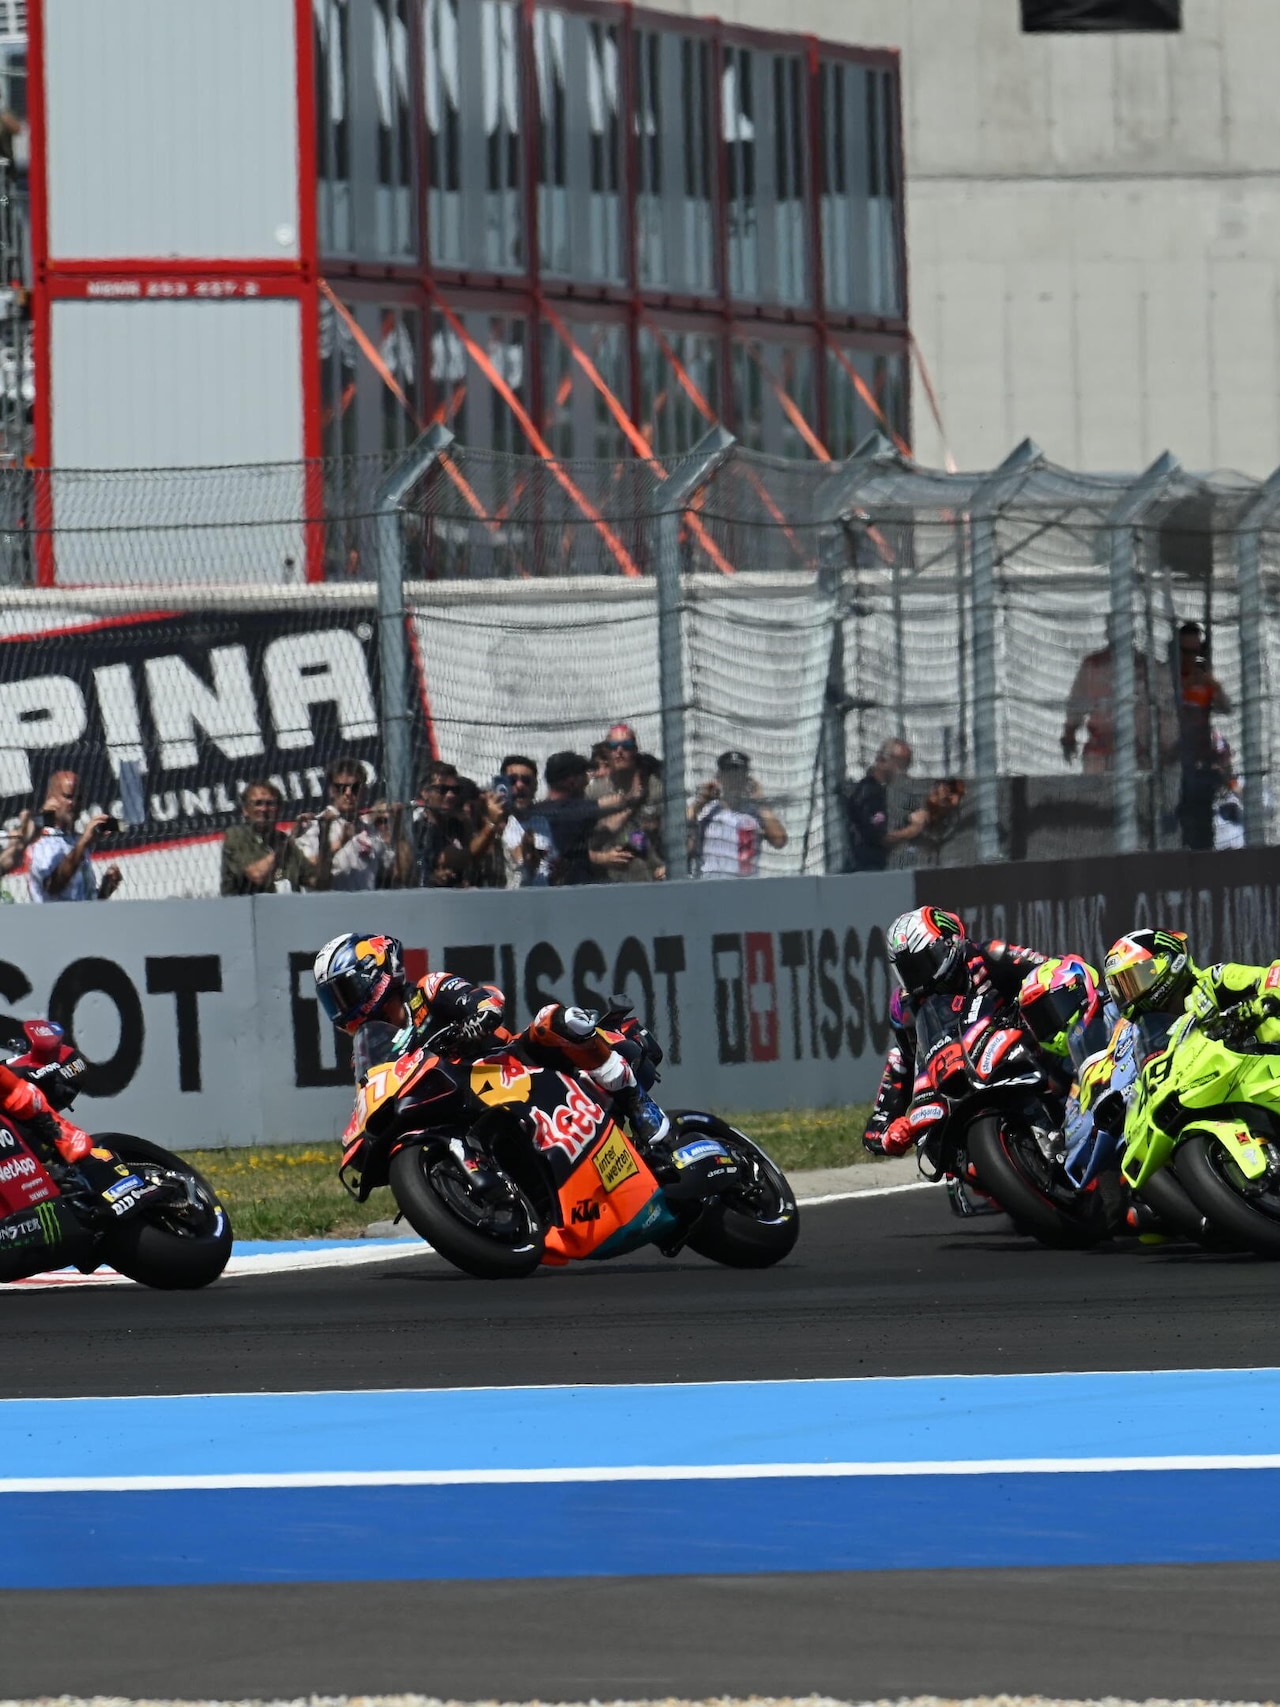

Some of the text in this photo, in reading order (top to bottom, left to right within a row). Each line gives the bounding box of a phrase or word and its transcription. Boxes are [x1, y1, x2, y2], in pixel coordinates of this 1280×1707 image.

[0, 953, 223, 1098] OT
[779, 924, 892, 1062] TISSO
[0, 1216, 42, 1241] NSTER
[571, 1198, 601, 1225] KTM
